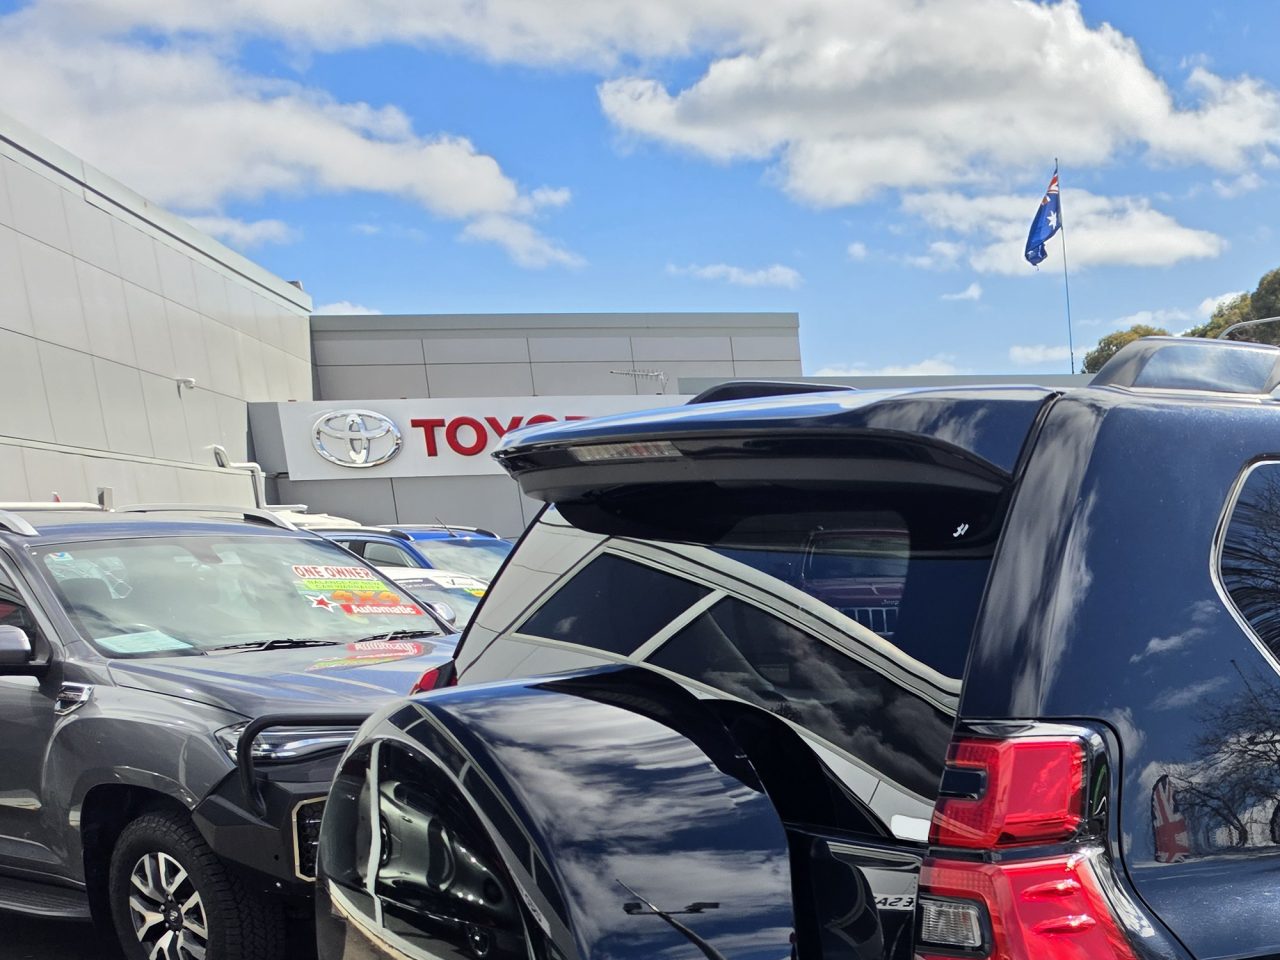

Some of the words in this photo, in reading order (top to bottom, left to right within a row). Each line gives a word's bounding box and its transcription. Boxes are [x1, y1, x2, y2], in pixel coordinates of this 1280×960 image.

[410, 414, 594, 457] TOY
[294, 566, 324, 578] ONE
[326, 567, 373, 579] OWNER
[351, 604, 417, 614] Automatic
